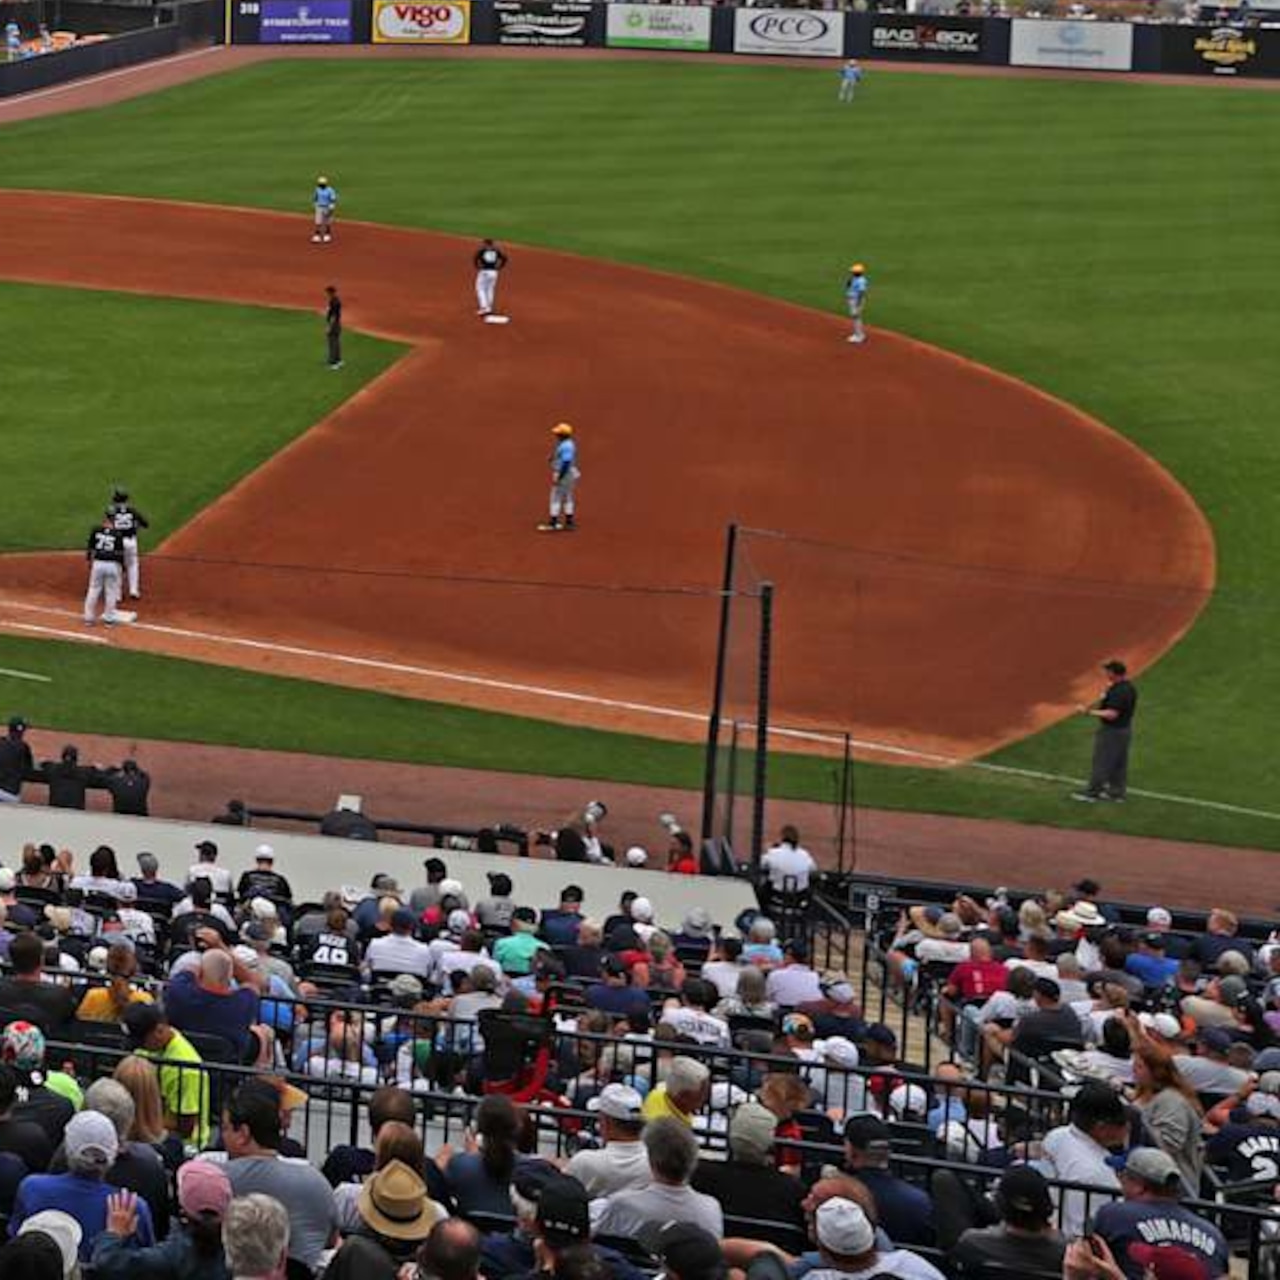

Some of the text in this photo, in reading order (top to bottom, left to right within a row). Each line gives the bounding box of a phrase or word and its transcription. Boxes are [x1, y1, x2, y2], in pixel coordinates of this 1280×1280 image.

[763, 16, 819, 36] PCC
[873, 27, 916, 41] BAD
[935, 30, 979, 45] BOY
[94, 532, 116, 551] 75
[1136, 1218, 1216, 1257] DIMAGGIO
